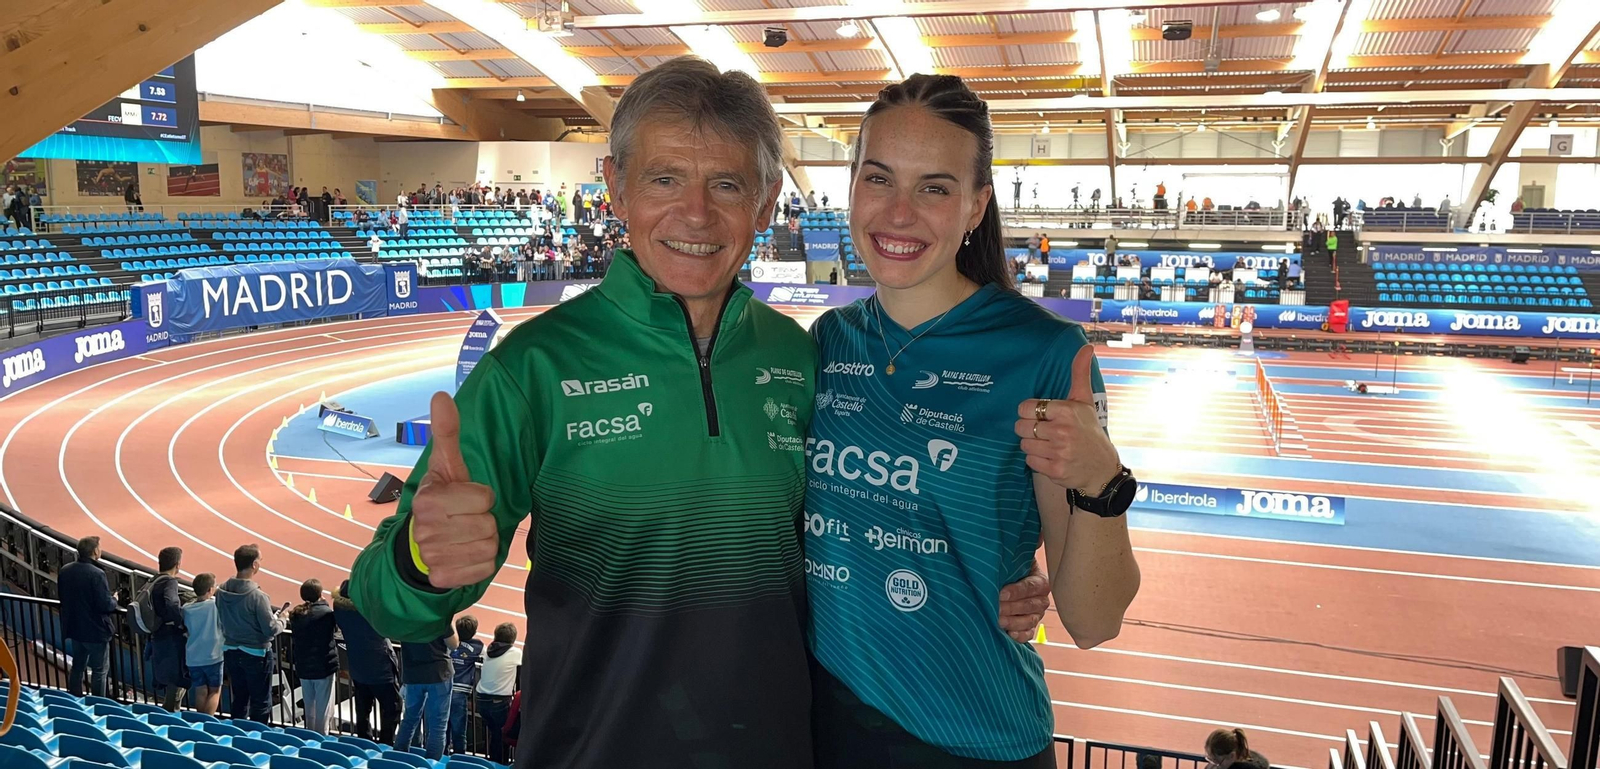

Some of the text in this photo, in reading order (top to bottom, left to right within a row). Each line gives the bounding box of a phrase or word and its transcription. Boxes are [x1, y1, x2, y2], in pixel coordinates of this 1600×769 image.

[151, 112, 167, 122] 7.72
[1037, 144, 1046, 154] H
[1557, 141, 1568, 152] G
[1385, 253, 1425, 262] MADRID
[1446, 254, 1488, 262] MADRID
[1508, 255, 1550, 264] MADRID
[202, 270, 353, 318] MADRID
[389, 301, 418, 311] MADRID
[1361, 311, 1430, 329] Joma
[1450, 312, 1521, 331] Joma
[74, 329, 125, 364] Joma
[2, 348, 46, 388] Joma
[823, 361, 875, 377] Mosttro
[941, 370, 959, 379] PLAYAS
[958, 372, 966, 380] DE
[584, 373, 650, 395] rasán
[831, 398, 864, 412] Castelló
[918, 408, 963, 423] Diputació
[335, 417, 365, 433] Iberdrola
[566, 414, 641, 440] Facsa
[915, 416, 966, 433] de Castelló
[594, 437, 616, 445] integral
[808, 478, 919, 511] ciclo integral del agua
[1151, 489, 1335, 519] Iberdrola Joma
[893, 577, 919, 588] GOLD
[890, 586, 922, 597] NUTRITION
